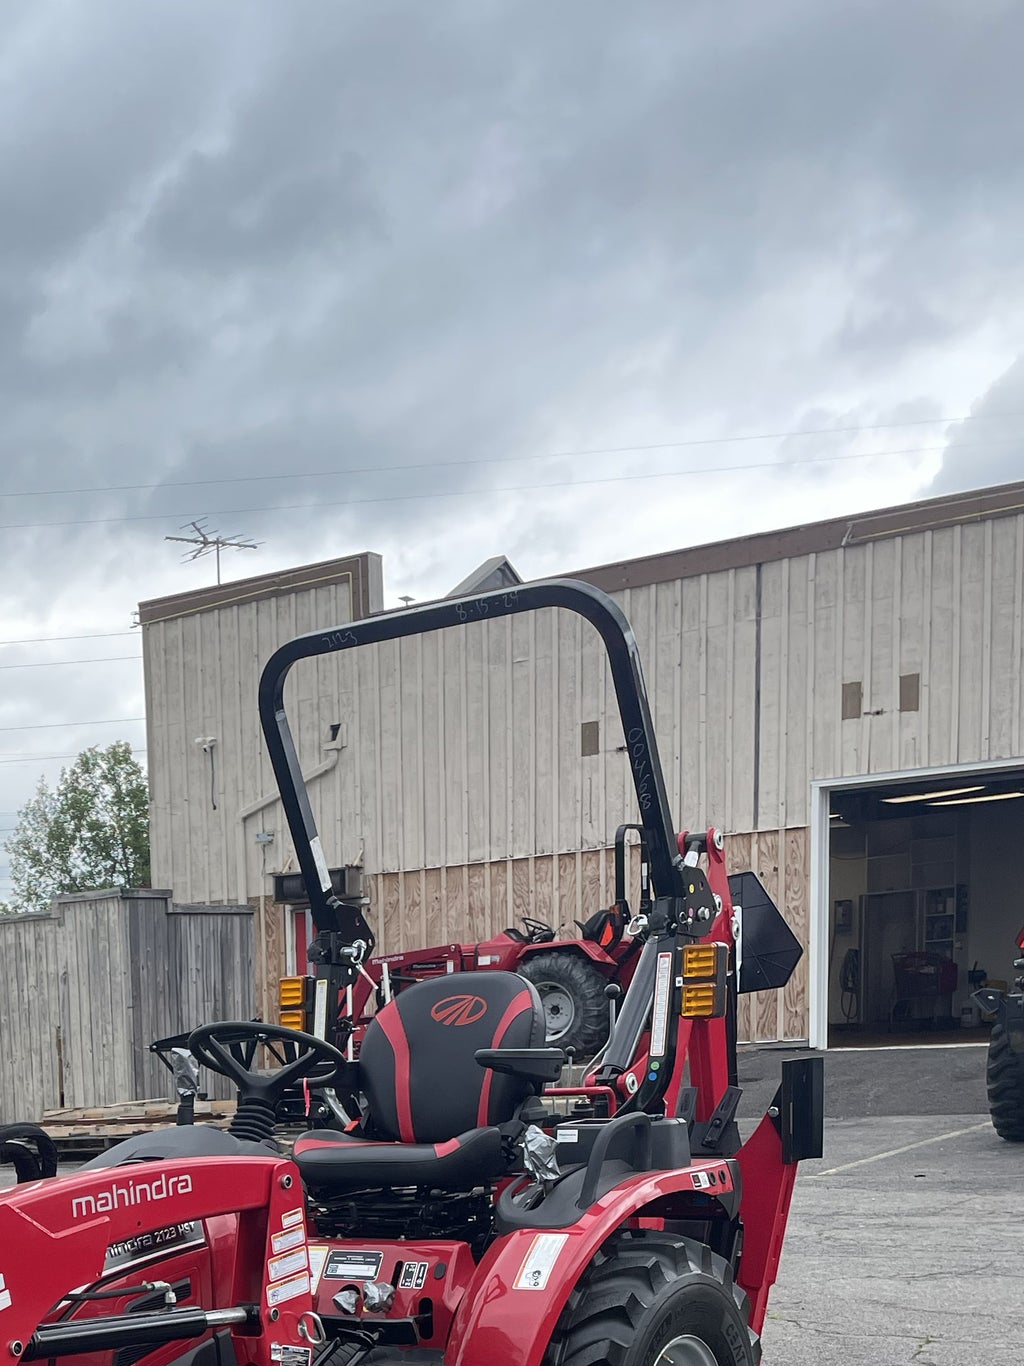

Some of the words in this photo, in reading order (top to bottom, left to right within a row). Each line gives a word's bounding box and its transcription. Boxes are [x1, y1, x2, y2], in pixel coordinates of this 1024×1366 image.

[321, 631, 358, 648] 2123
[71, 1173, 193, 1218] mahindra
[154, 1227, 176, 1243] 2123
[177, 1221, 195, 1236] HST
[726, 1323, 746, 1363] CEAT
